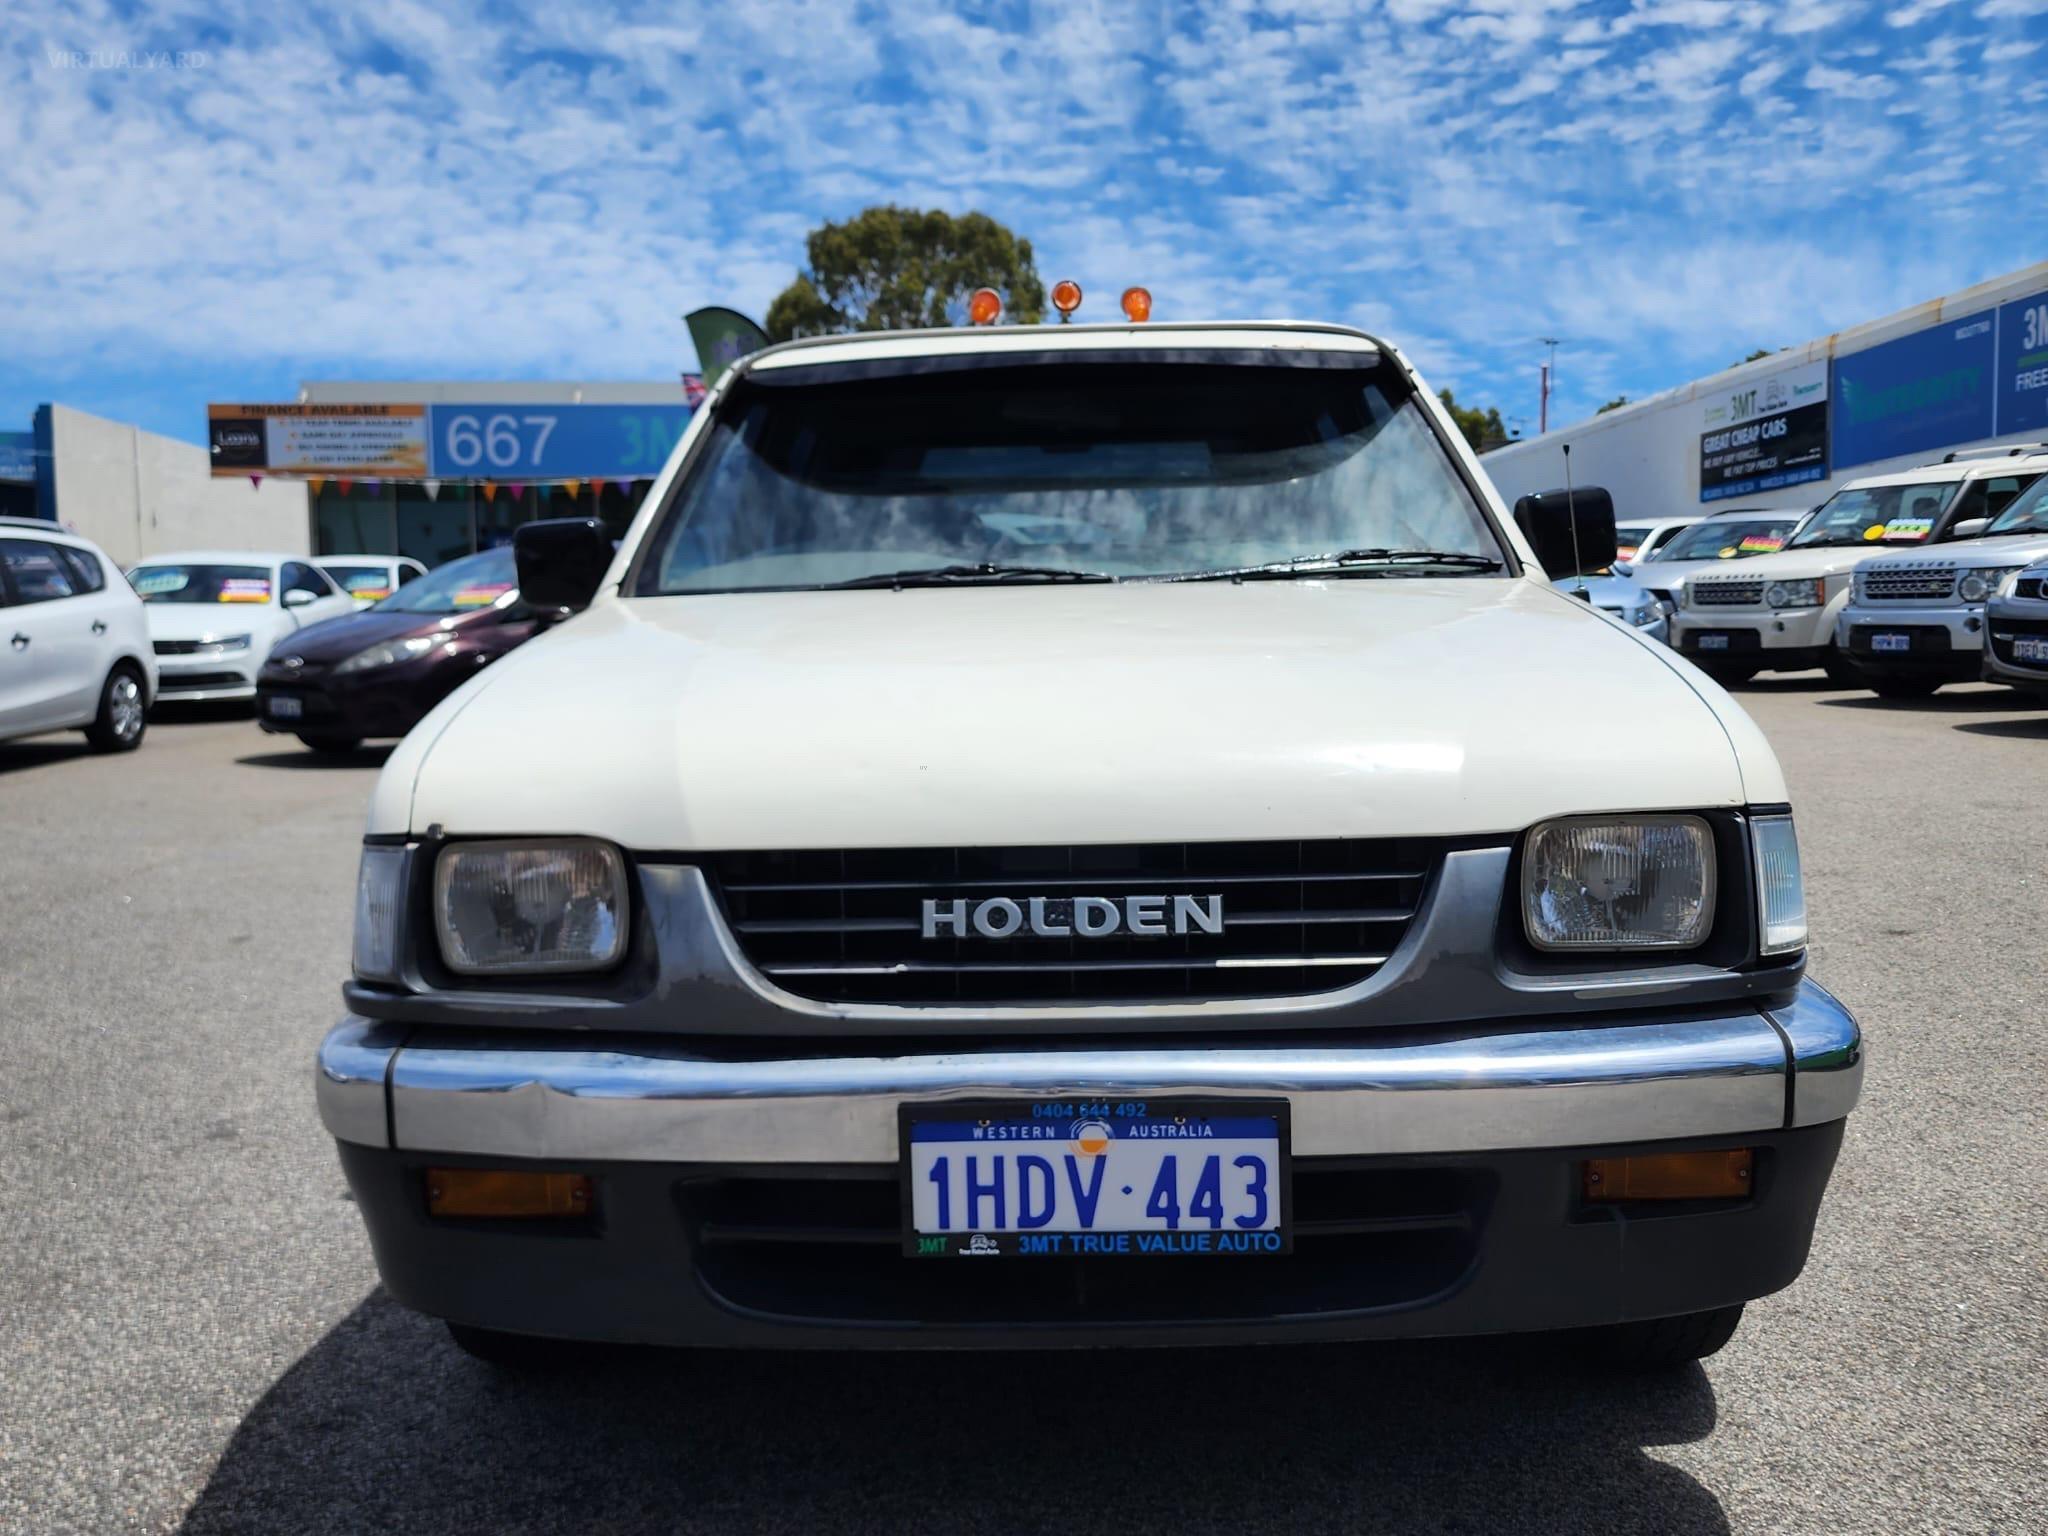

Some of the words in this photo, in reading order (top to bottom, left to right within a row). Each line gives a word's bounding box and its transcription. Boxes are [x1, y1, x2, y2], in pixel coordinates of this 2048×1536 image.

[241, 404, 305, 416] FINANCE
[310, 404, 389, 416] AVAILABLE
[1731, 389, 1758, 421] 3MT
[446, 414, 558, 467] 667
[1703, 432, 1730, 454] GREAT
[1730, 424, 1760, 447] CHEAP
[1761, 417, 1788, 439] CARS
[921, 894, 1224, 938] HOLDEN
[1032, 1103, 1073, 1118] 0404
[1115, 1103, 1147, 1117] 492
[972, 1125, 1055, 1139] WESTERN
[1129, 1124, 1213, 1138] AUSTRALIA
[917, 1236, 947, 1254] 3MT
[1019, 1235, 1065, 1253] 3MT
[1069, 1235, 1129, 1253] TRUE
[1136, 1234, 1211, 1252] VALUE
[1216, 1233, 1281, 1252] AUTO
